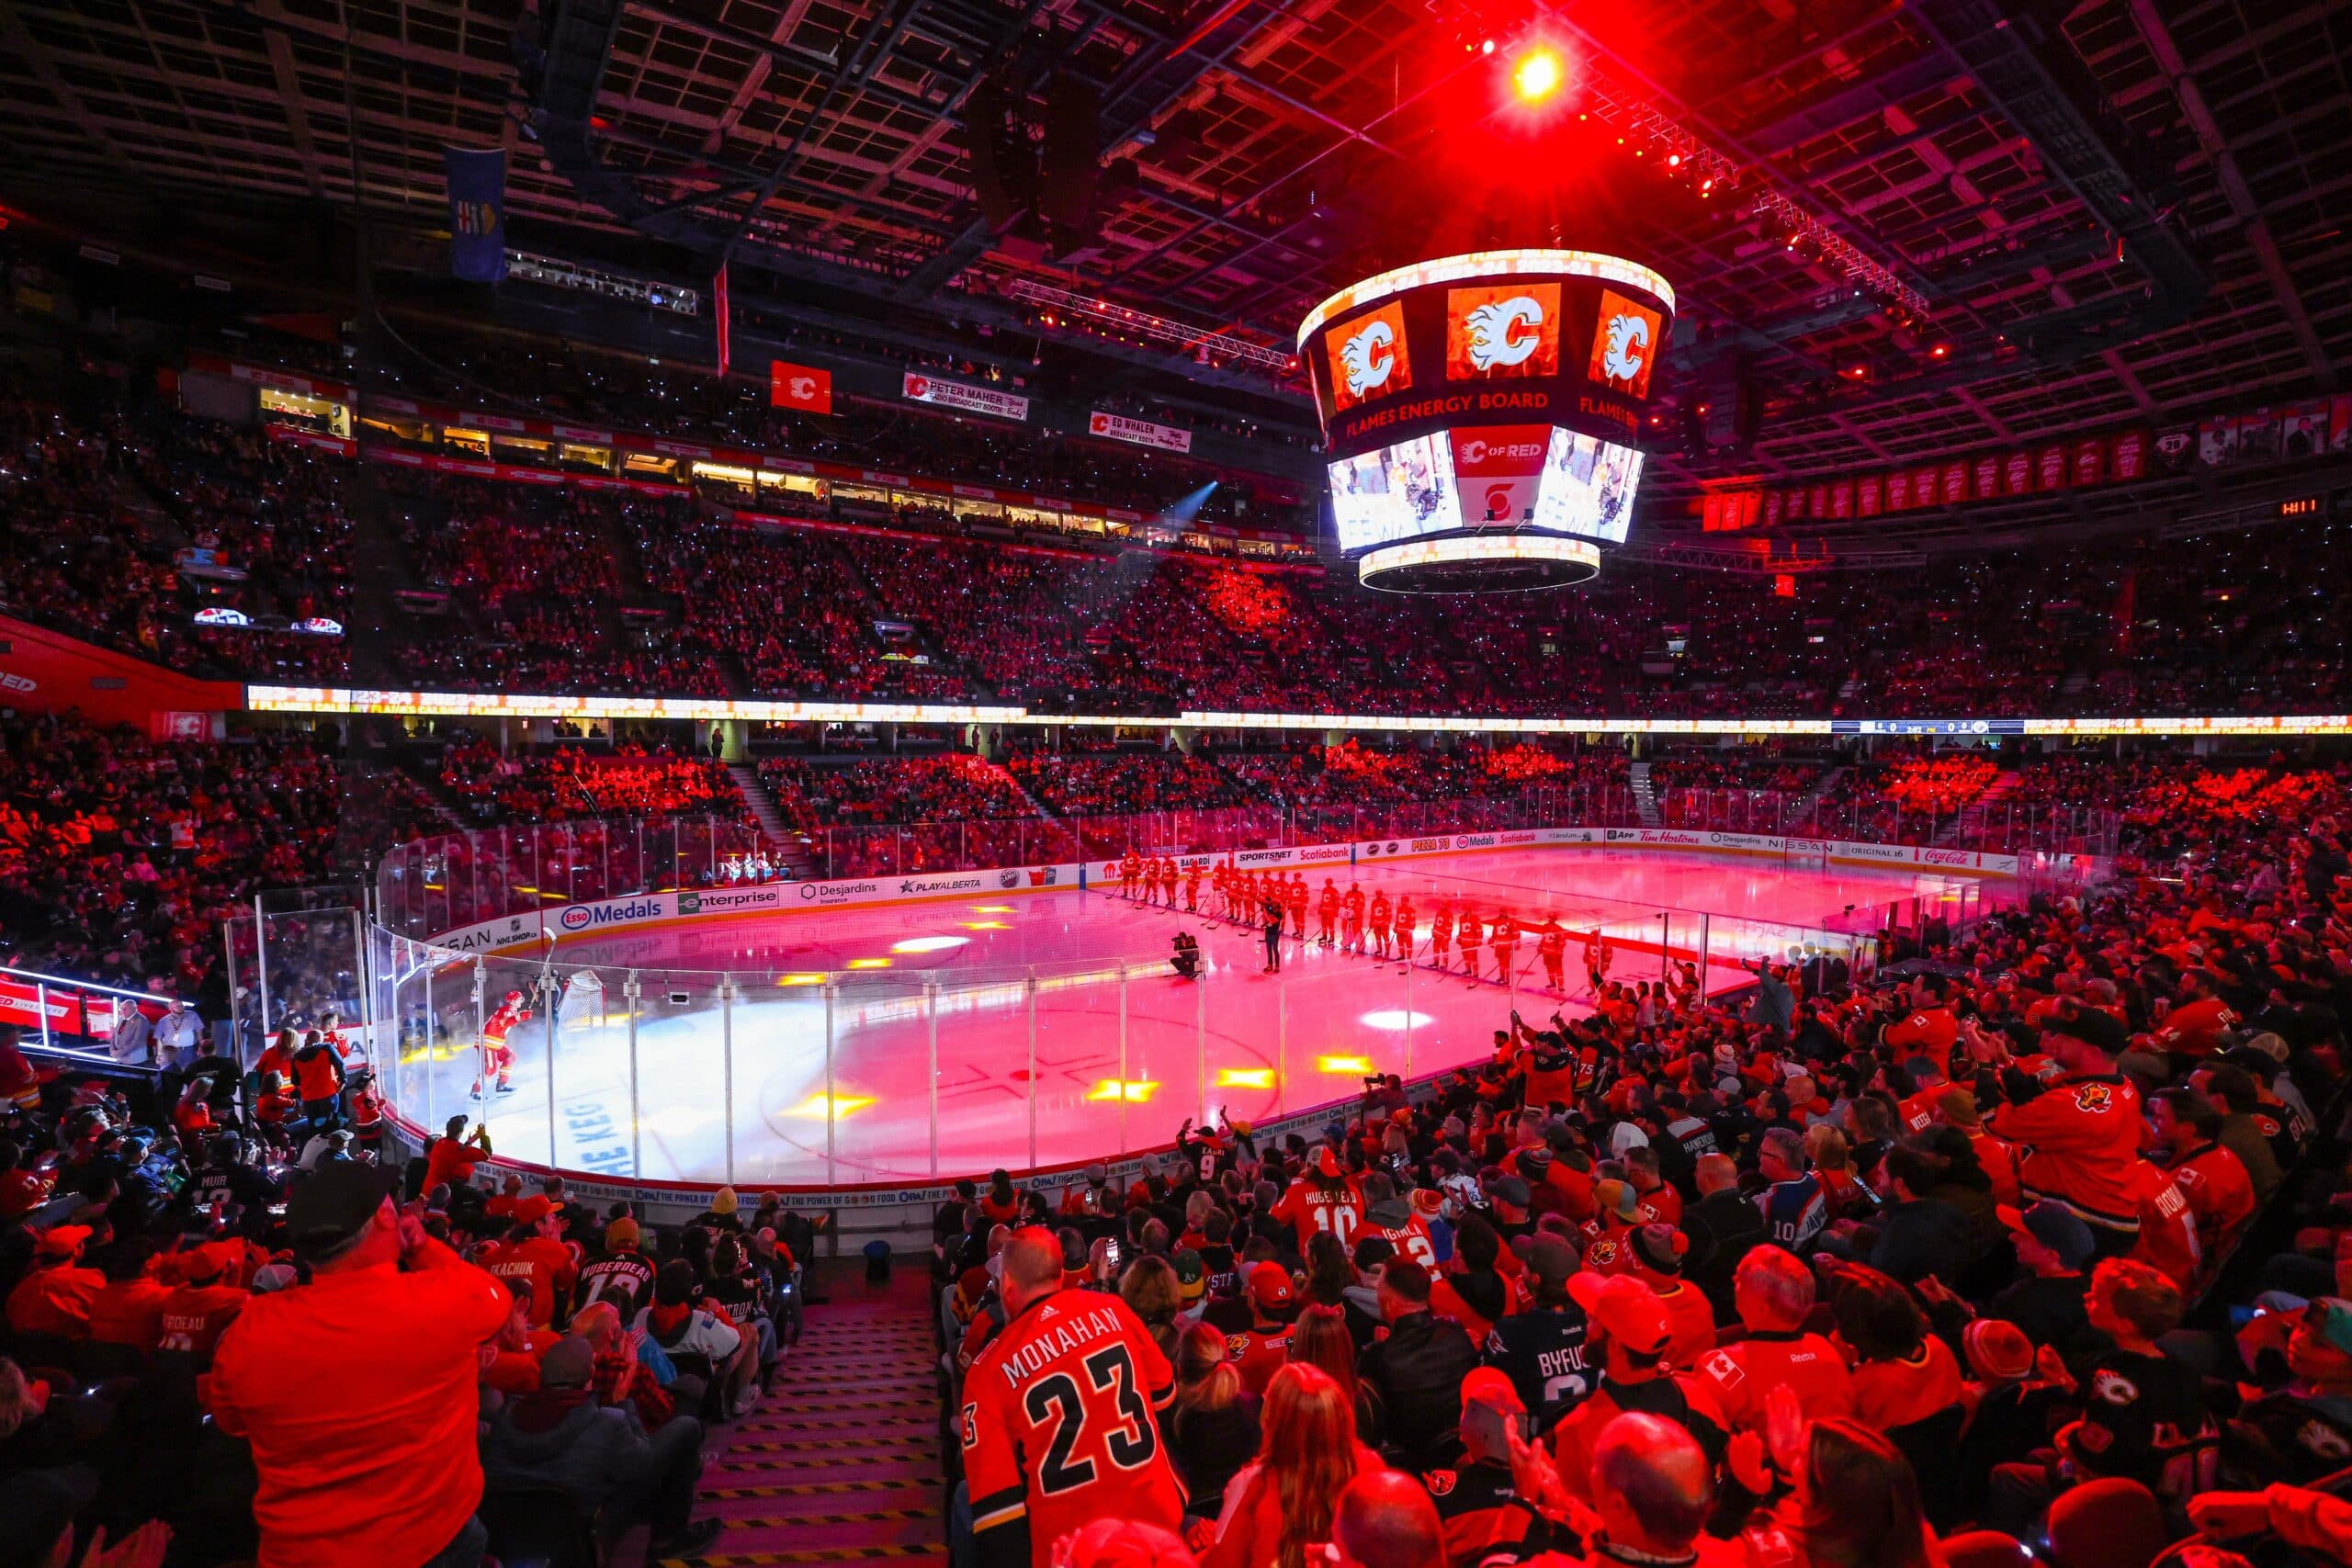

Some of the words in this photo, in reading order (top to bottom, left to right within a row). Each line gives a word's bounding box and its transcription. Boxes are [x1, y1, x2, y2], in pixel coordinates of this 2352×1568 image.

[930, 381, 965, 396] PETER
[967, 389, 1002, 405] MAHER
[1346, 408, 1396, 438] FLAMES
[1399, 395, 1474, 422] ENERGY
[1479, 392, 1548, 410] BOARD
[1579, 396, 1624, 422] FLAMES
[1113, 417, 1123, 427] ED
[1125, 419, 1155, 434] WHALEN
[1488, 446, 1506, 457] OF
[1507, 444, 1542, 457] RED
[0, 671, 37, 692] ED
[1469, 835, 1495, 847] Medals
[1500, 832, 1536, 843] Scotiabank
[1640, 830, 1657, 842] Tim
[1659, 830, 1699, 844] Hortons
[1724, 834, 1761, 845] Desjardins
[1412, 839, 1437, 852] PIZZA
[1439, 838, 1450, 850] 73
[1769, 840, 1833, 852] NISSAN
[1238, 850, 1293, 862] SPORTSNET
[1300, 847, 1349, 861] Scotiabank
[1851, 847, 1893, 857] ORIGINAL
[1894, 850, 1904, 858] 16
[820, 883, 876, 897] Desjardins
[683, 891, 776, 909] enterprise
[820, 897, 848, 905] Insurance
[565, 912, 587, 924] Esso
[594, 898, 662, 923] Medals
[1579, 1063, 1594, 1075] 75
[1200, 1155, 1216, 1181] 9
[202, 1175, 227, 1187] MUIR
[662, 1193, 673, 1201] THE
[674, 1194, 698, 1203] POWER
[700, 1195, 709, 1203] OF
[792, 1197, 805, 1205] THE
[807, 1196, 831, 1204] POWER
[833, 1196, 843, 1204] OF
[877, 1193, 896, 1202] FOOD
[927, 1190, 942, 1199] THE
[1382, 1223, 1423, 1241] IGINLA
[1773, 1220, 1795, 1242] 10
[582, 1260, 651, 1282] HUBERDEAU
[1001, 1307, 1123, 1389] MONAHAN
[1023, 1341, 1157, 1496] 23
